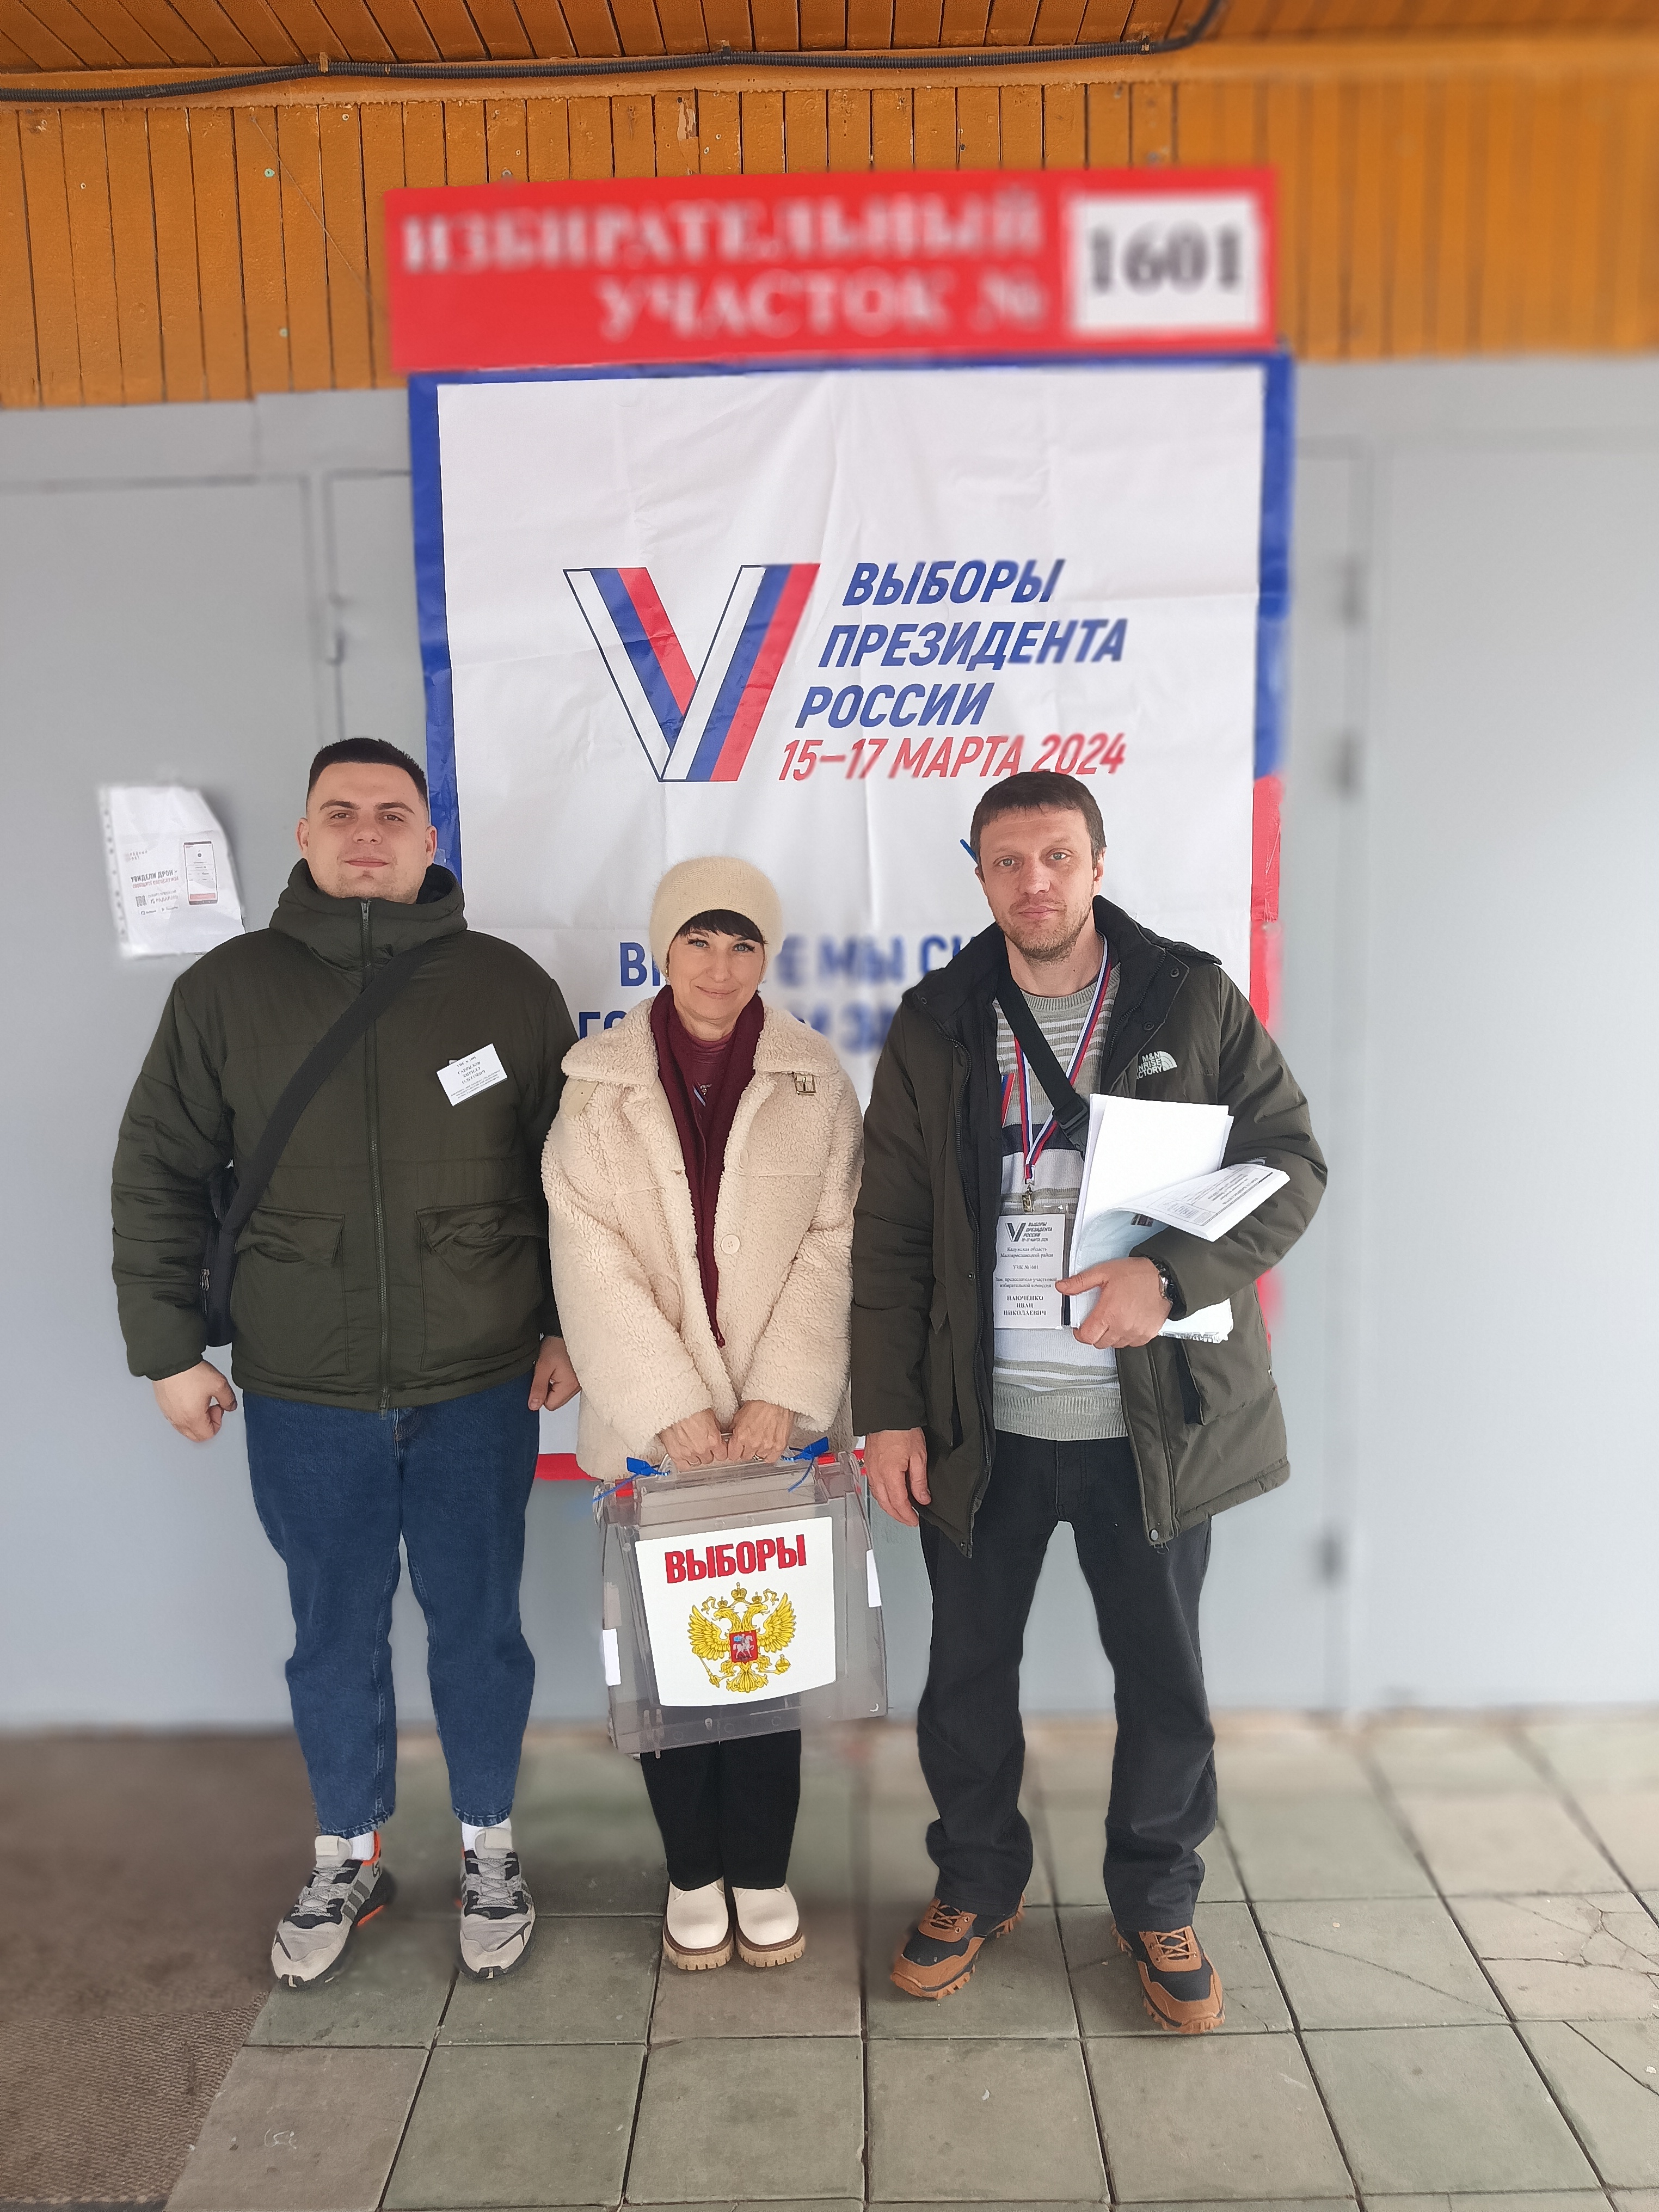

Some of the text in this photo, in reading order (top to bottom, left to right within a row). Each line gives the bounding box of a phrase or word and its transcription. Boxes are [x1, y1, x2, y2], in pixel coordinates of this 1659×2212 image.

[403, 188, 1042, 272] ИЗБИРАТЕЛЬНЫЙ
[1090, 222, 1240, 294] 1601
[598, 268, 1045, 339] УЧАСТОК №
[841, 560, 1065, 606] ВЫБОРЫ
[818, 618, 1127, 671] ПРЕЗИДЕНТА
[795, 683, 994, 729] РОССИИ
[889, 735, 1024, 779] МАРТА
[1034, 733, 1126, 776] 2024
[131, 872, 156, 883] УВИДЕЛИ
[157, 869, 173, 878] ДРОН
[1137, 1058, 1162, 1072] NRISE
[1142, 1051, 1160, 1062] M&N
[665, 1535, 807, 1584] ВЫБОРЫ
